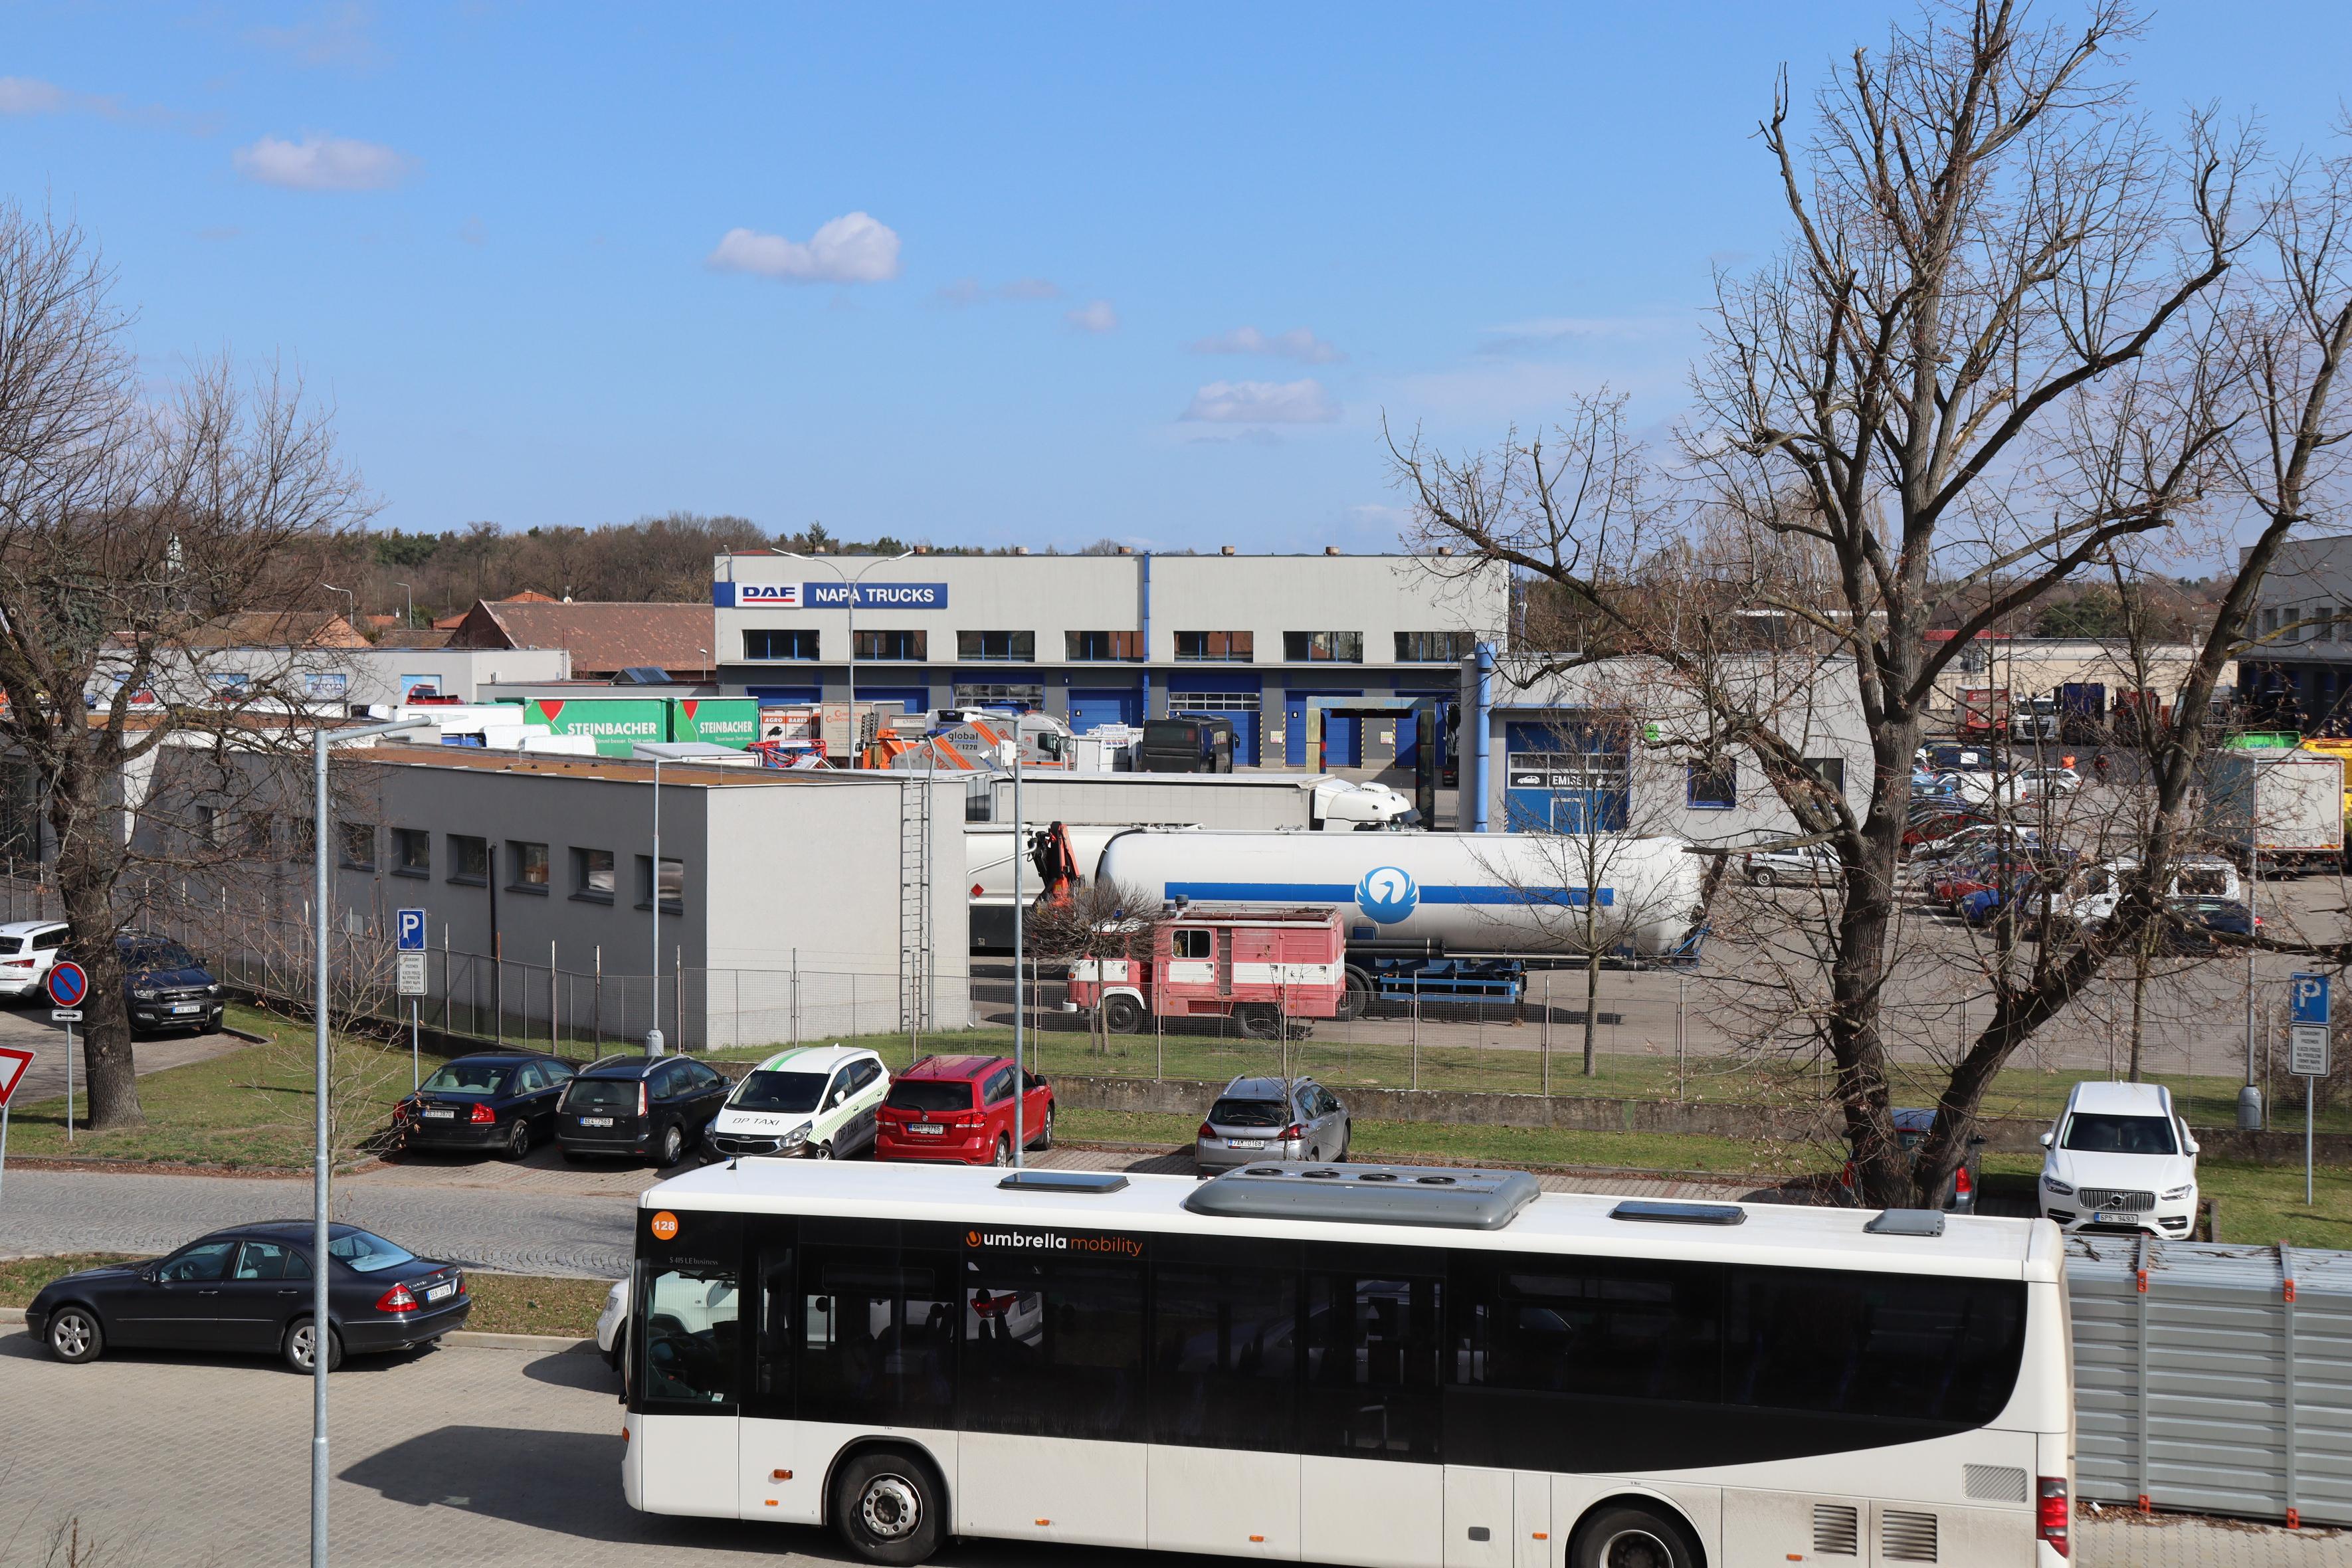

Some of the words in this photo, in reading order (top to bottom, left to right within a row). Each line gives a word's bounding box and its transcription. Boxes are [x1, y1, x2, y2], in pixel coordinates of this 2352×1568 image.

[743, 587, 795, 597] DAF
[816, 588, 861, 603] NAPA
[866, 589, 934, 603] TRUCKS
[567, 722, 657, 735] STEINBACHER
[700, 720, 753, 734] STEINBACHER
[948, 732, 978, 742] global
[403, 914, 419, 939] P
[2299, 979, 2321, 1007] P
[847, 1119, 858, 1136] TAXI
[654, 1221, 675, 1230] 128
[983, 1231, 1067, 1249] umbrella
[1070, 1236, 1143, 1257] mobility
